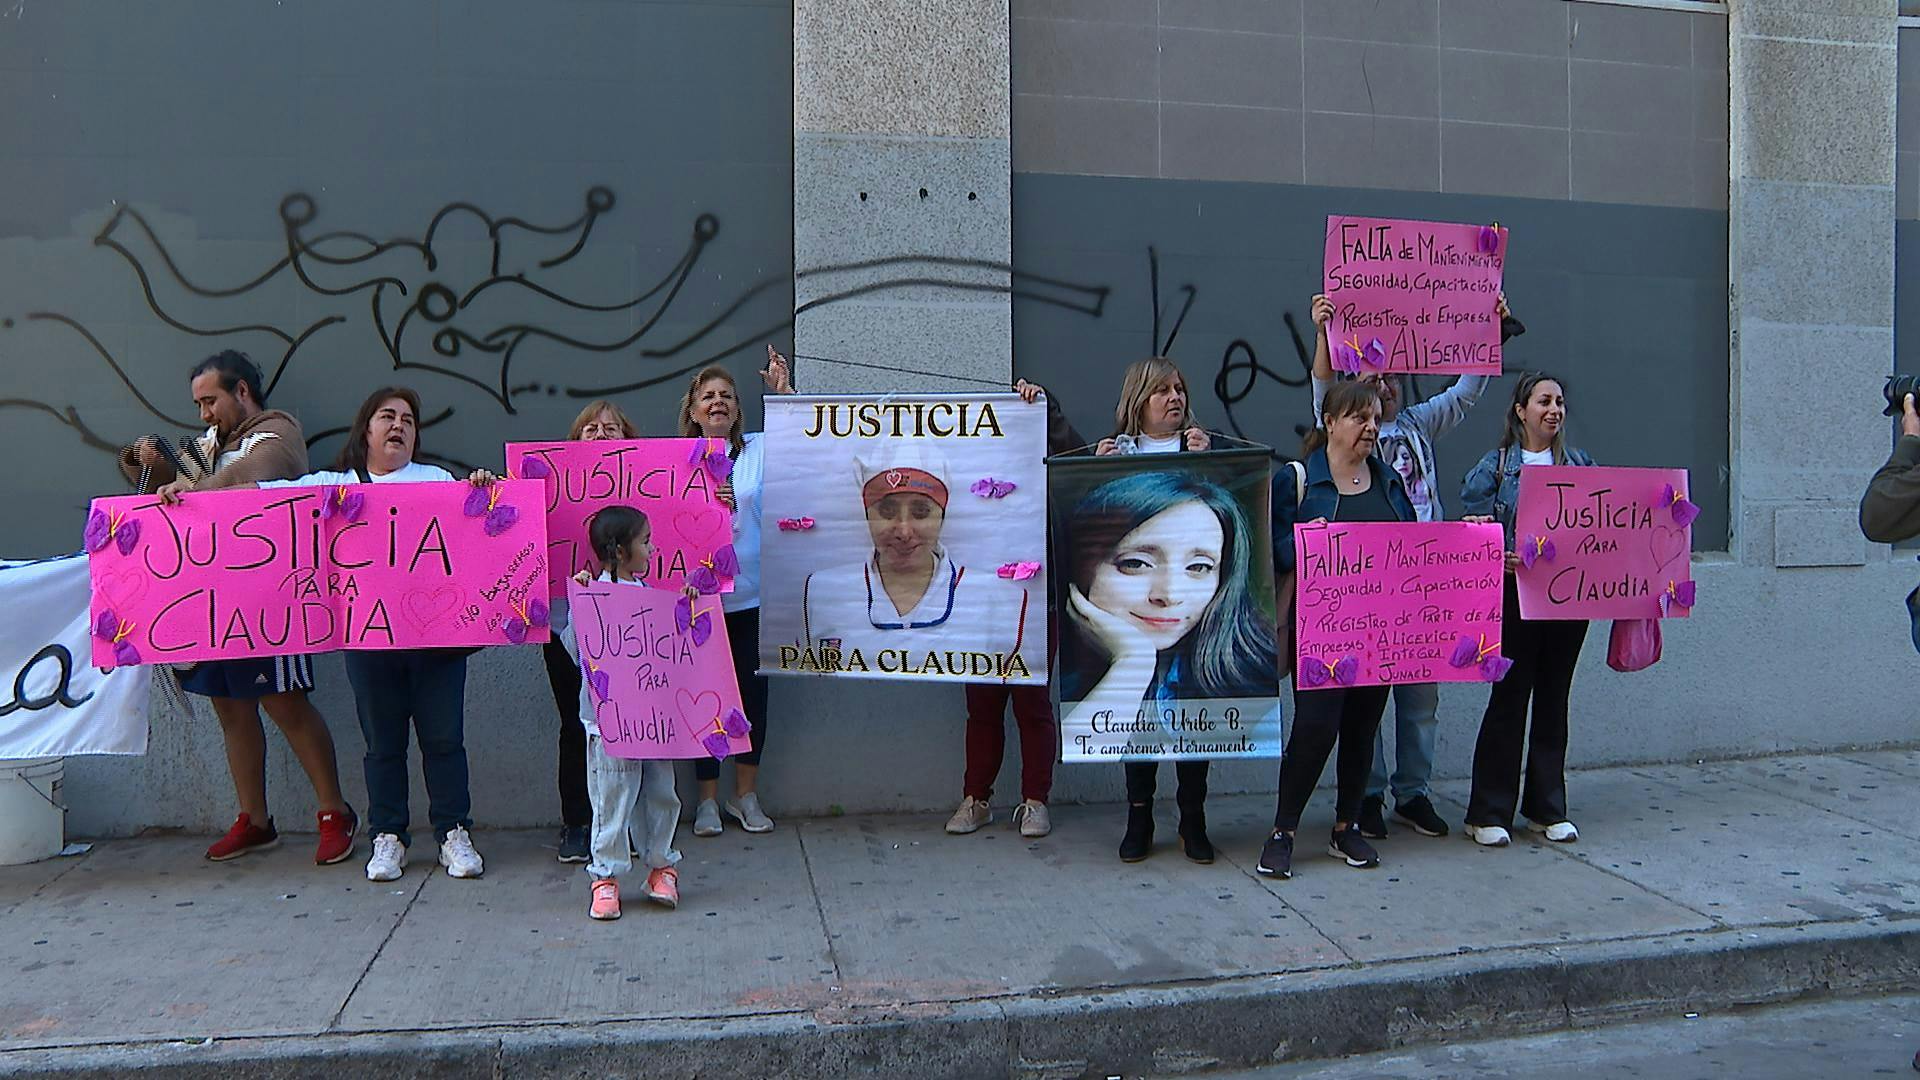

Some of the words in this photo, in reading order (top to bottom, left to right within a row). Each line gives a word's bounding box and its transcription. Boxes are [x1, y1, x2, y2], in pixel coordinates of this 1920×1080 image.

[1341, 224, 1393, 265] FALTA
[804, 402, 1005, 439] JUSTICIA
[1575, 533, 1618, 555] PARA
[277, 566, 360, 600] PARA
[634, 662, 669, 692] PARA
[779, 644, 870, 674] PARA
[876, 648, 1032, 679] CLAUDIA
[1091, 709, 1157, 734] Claudia
[1163, 707, 1217, 733] Uribe
[1224, 706, 1245, 732] B.
[1074, 733, 1096, 756] Te
[1100, 740, 1167, 756] amaremos
[1172, 734, 1258, 755] eternamente
